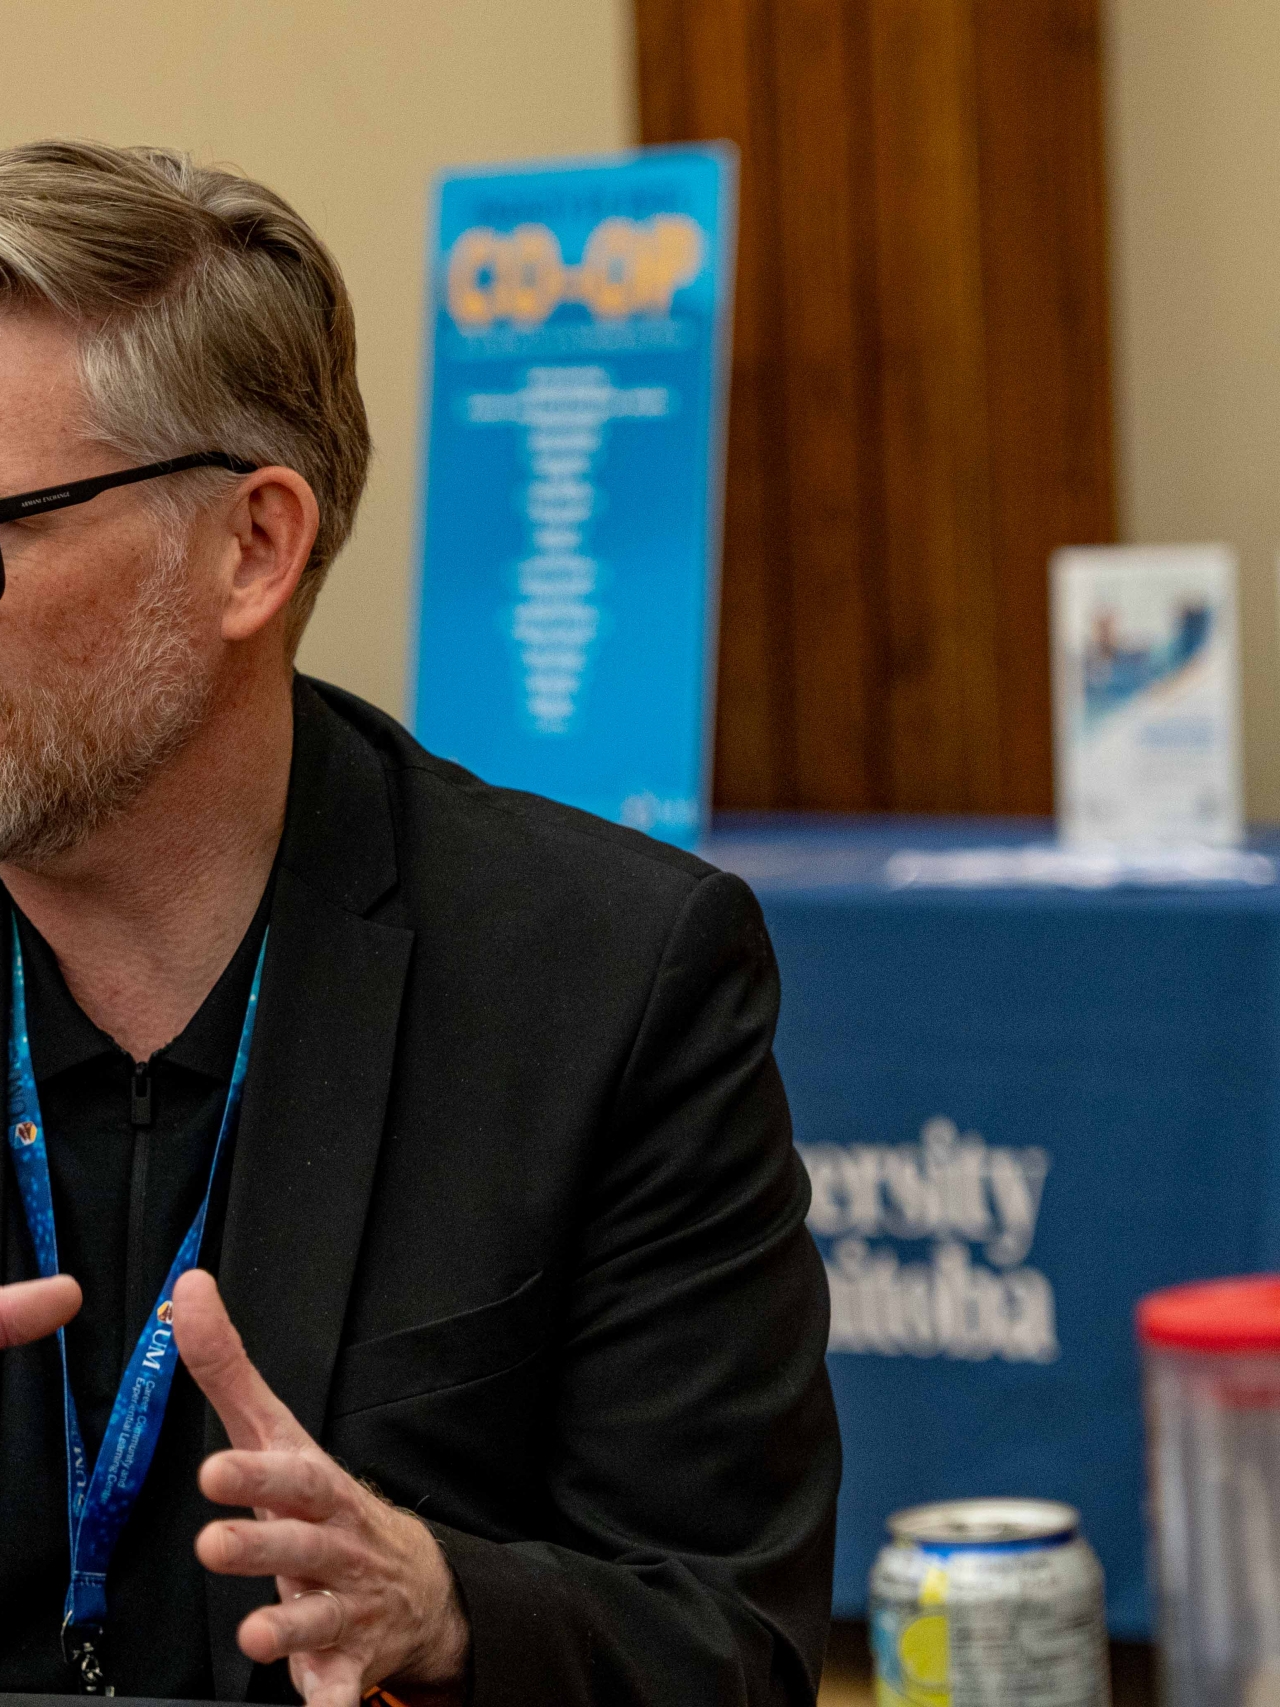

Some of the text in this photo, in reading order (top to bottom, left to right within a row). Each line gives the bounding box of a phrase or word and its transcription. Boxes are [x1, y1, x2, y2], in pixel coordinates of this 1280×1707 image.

[798, 1117, 1049, 1265] ersity
[828, 1240, 1061, 1363] itoba
[142, 1329, 172, 1370] UM
[122, 1377, 145, 1432] Experiential
[108, 1432, 130, 1474] Learning
[121, 1415, 147, 1469] Community
[117, 1469, 129, 1488] and
